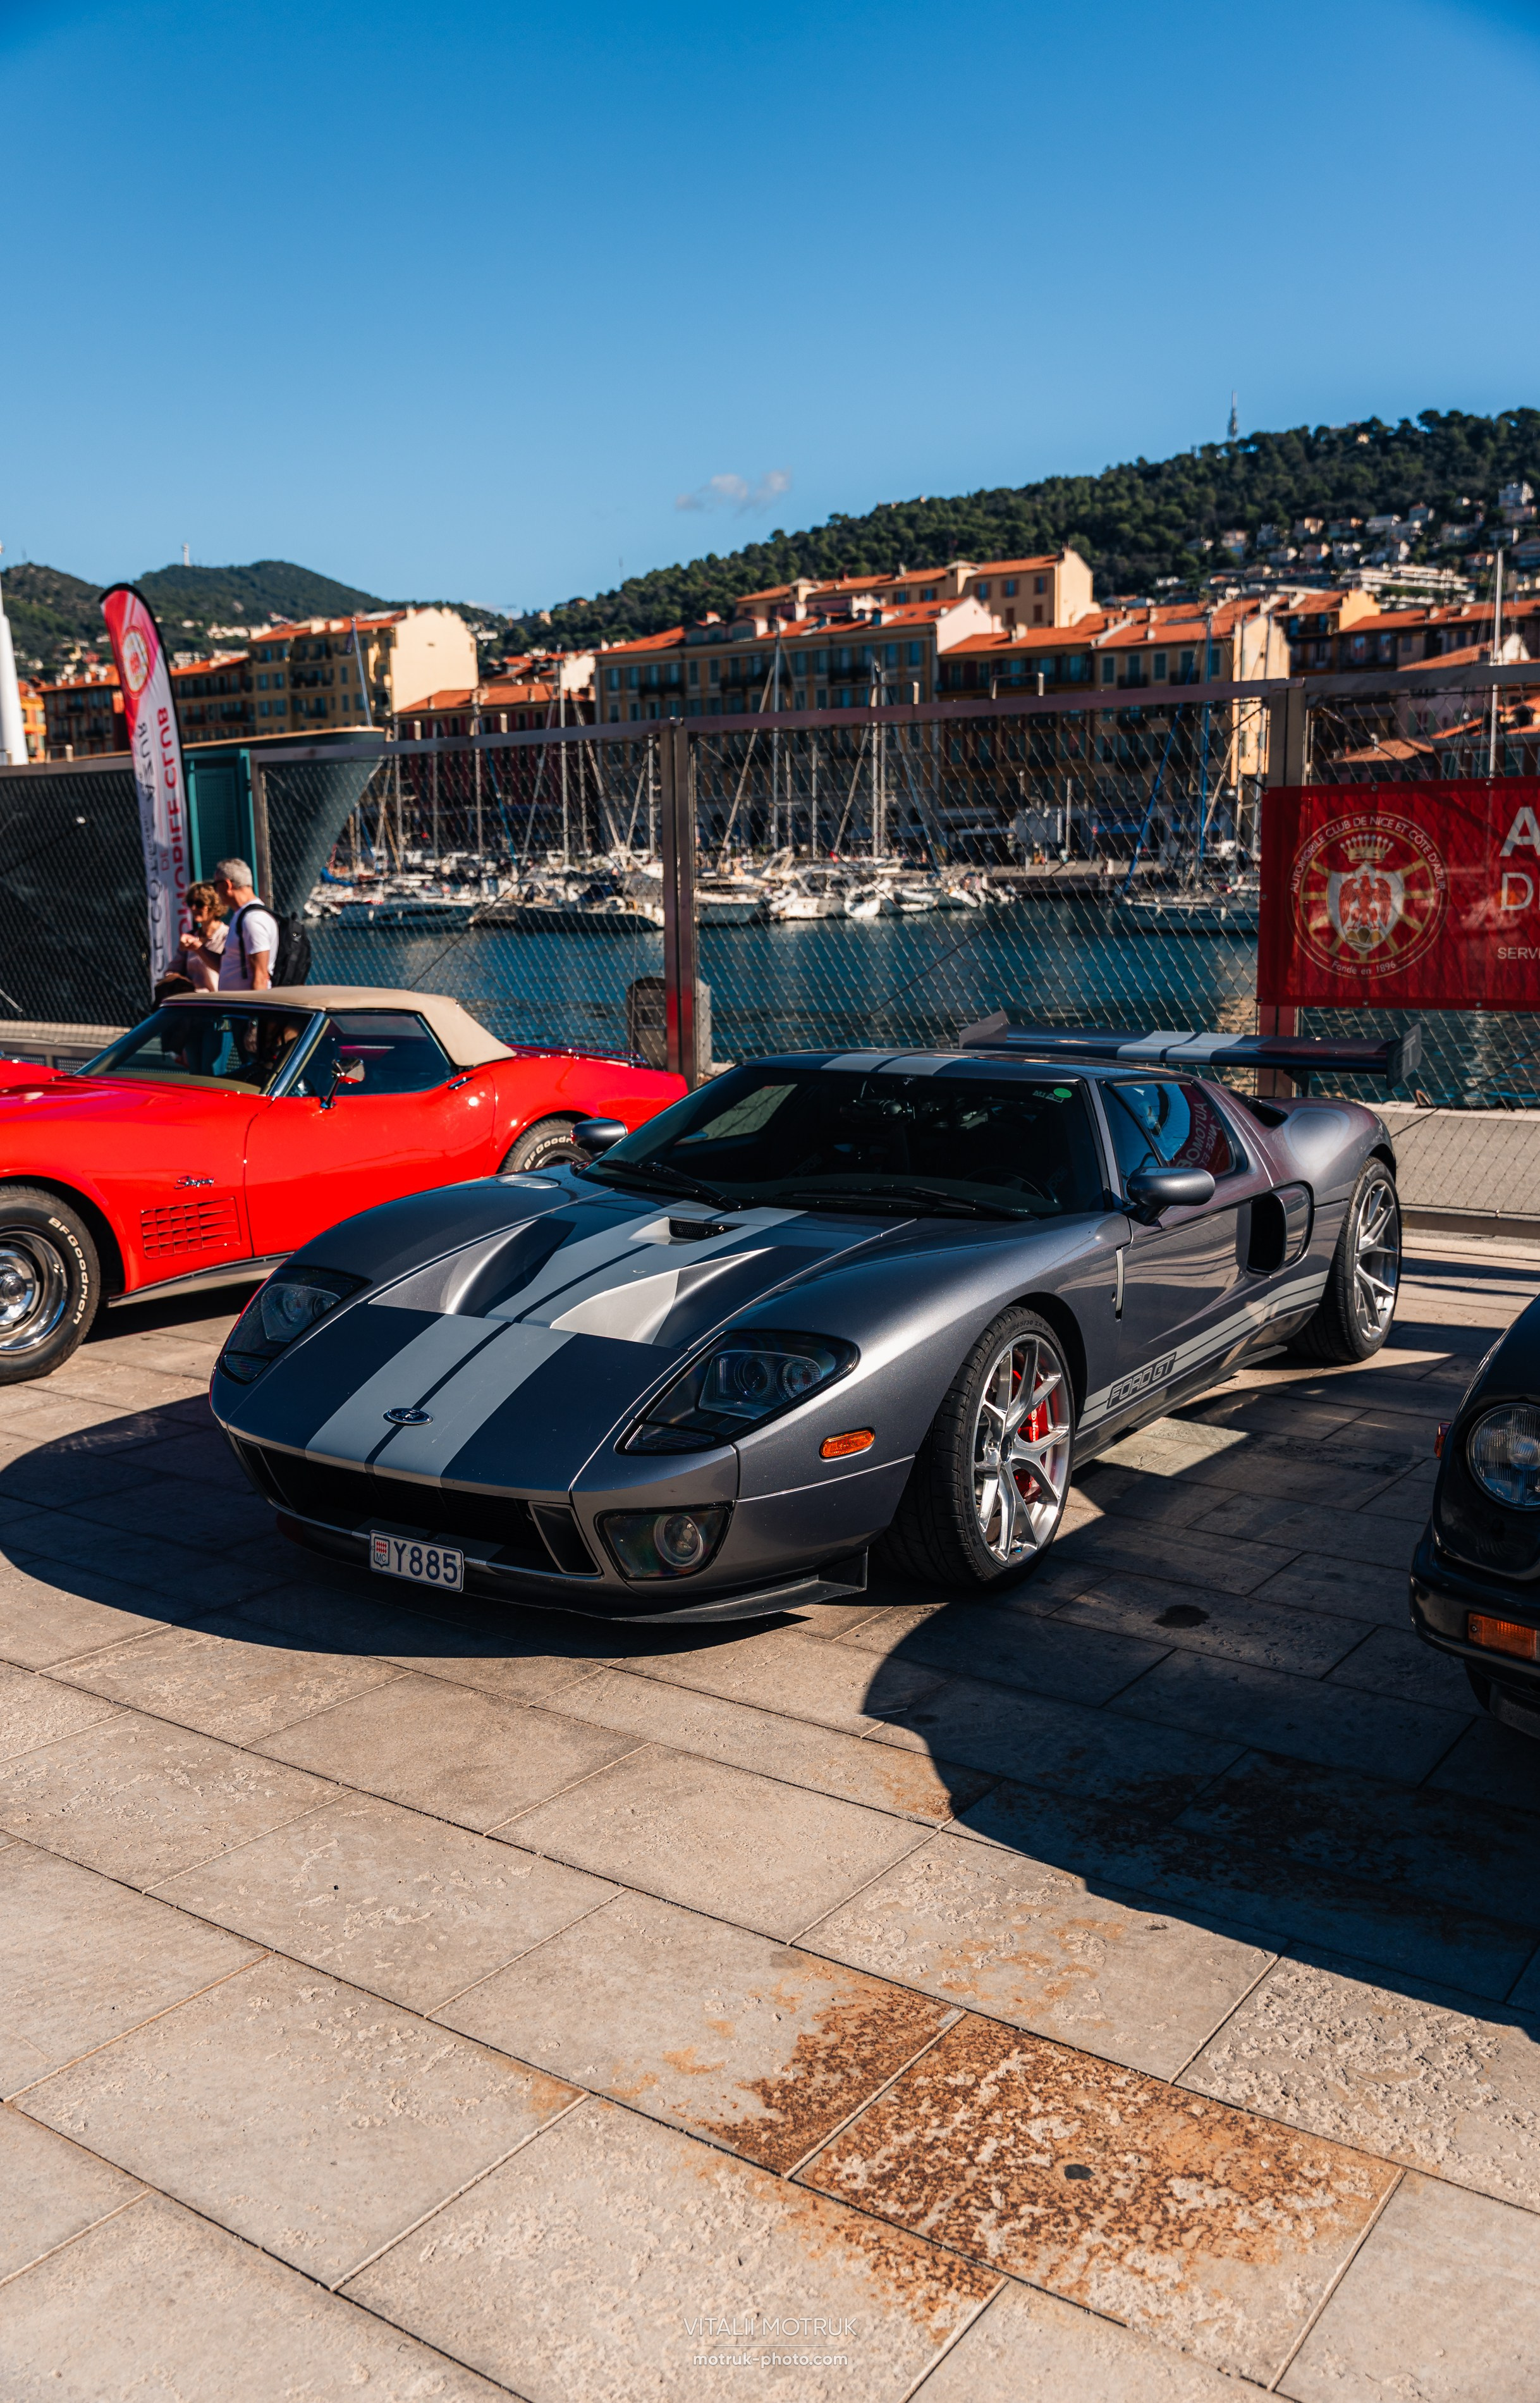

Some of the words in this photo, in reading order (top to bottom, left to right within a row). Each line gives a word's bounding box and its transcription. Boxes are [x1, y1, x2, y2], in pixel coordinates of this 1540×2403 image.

[1290, 834, 1326, 894] AUTOMOBILE
[1326, 820, 1352, 837] CLUB
[1354, 816, 1367, 827] DE
[1370, 816, 1395, 828] NICE
[1395, 821, 1409, 833] ET
[1409, 830, 1432, 854] CÔTE
[1427, 852, 1446, 892] D'AZUR
[1501, 873, 1540, 910] D
[1331, 961, 1357, 974] Fondé
[1376, 961, 1396, 973] 1896
[1108, 1367, 1152, 1406] FORD
[1152, 1355, 1175, 1381] GT
[376, 1552, 386, 1563] MC
[393, 1541, 458, 1583] Y885
